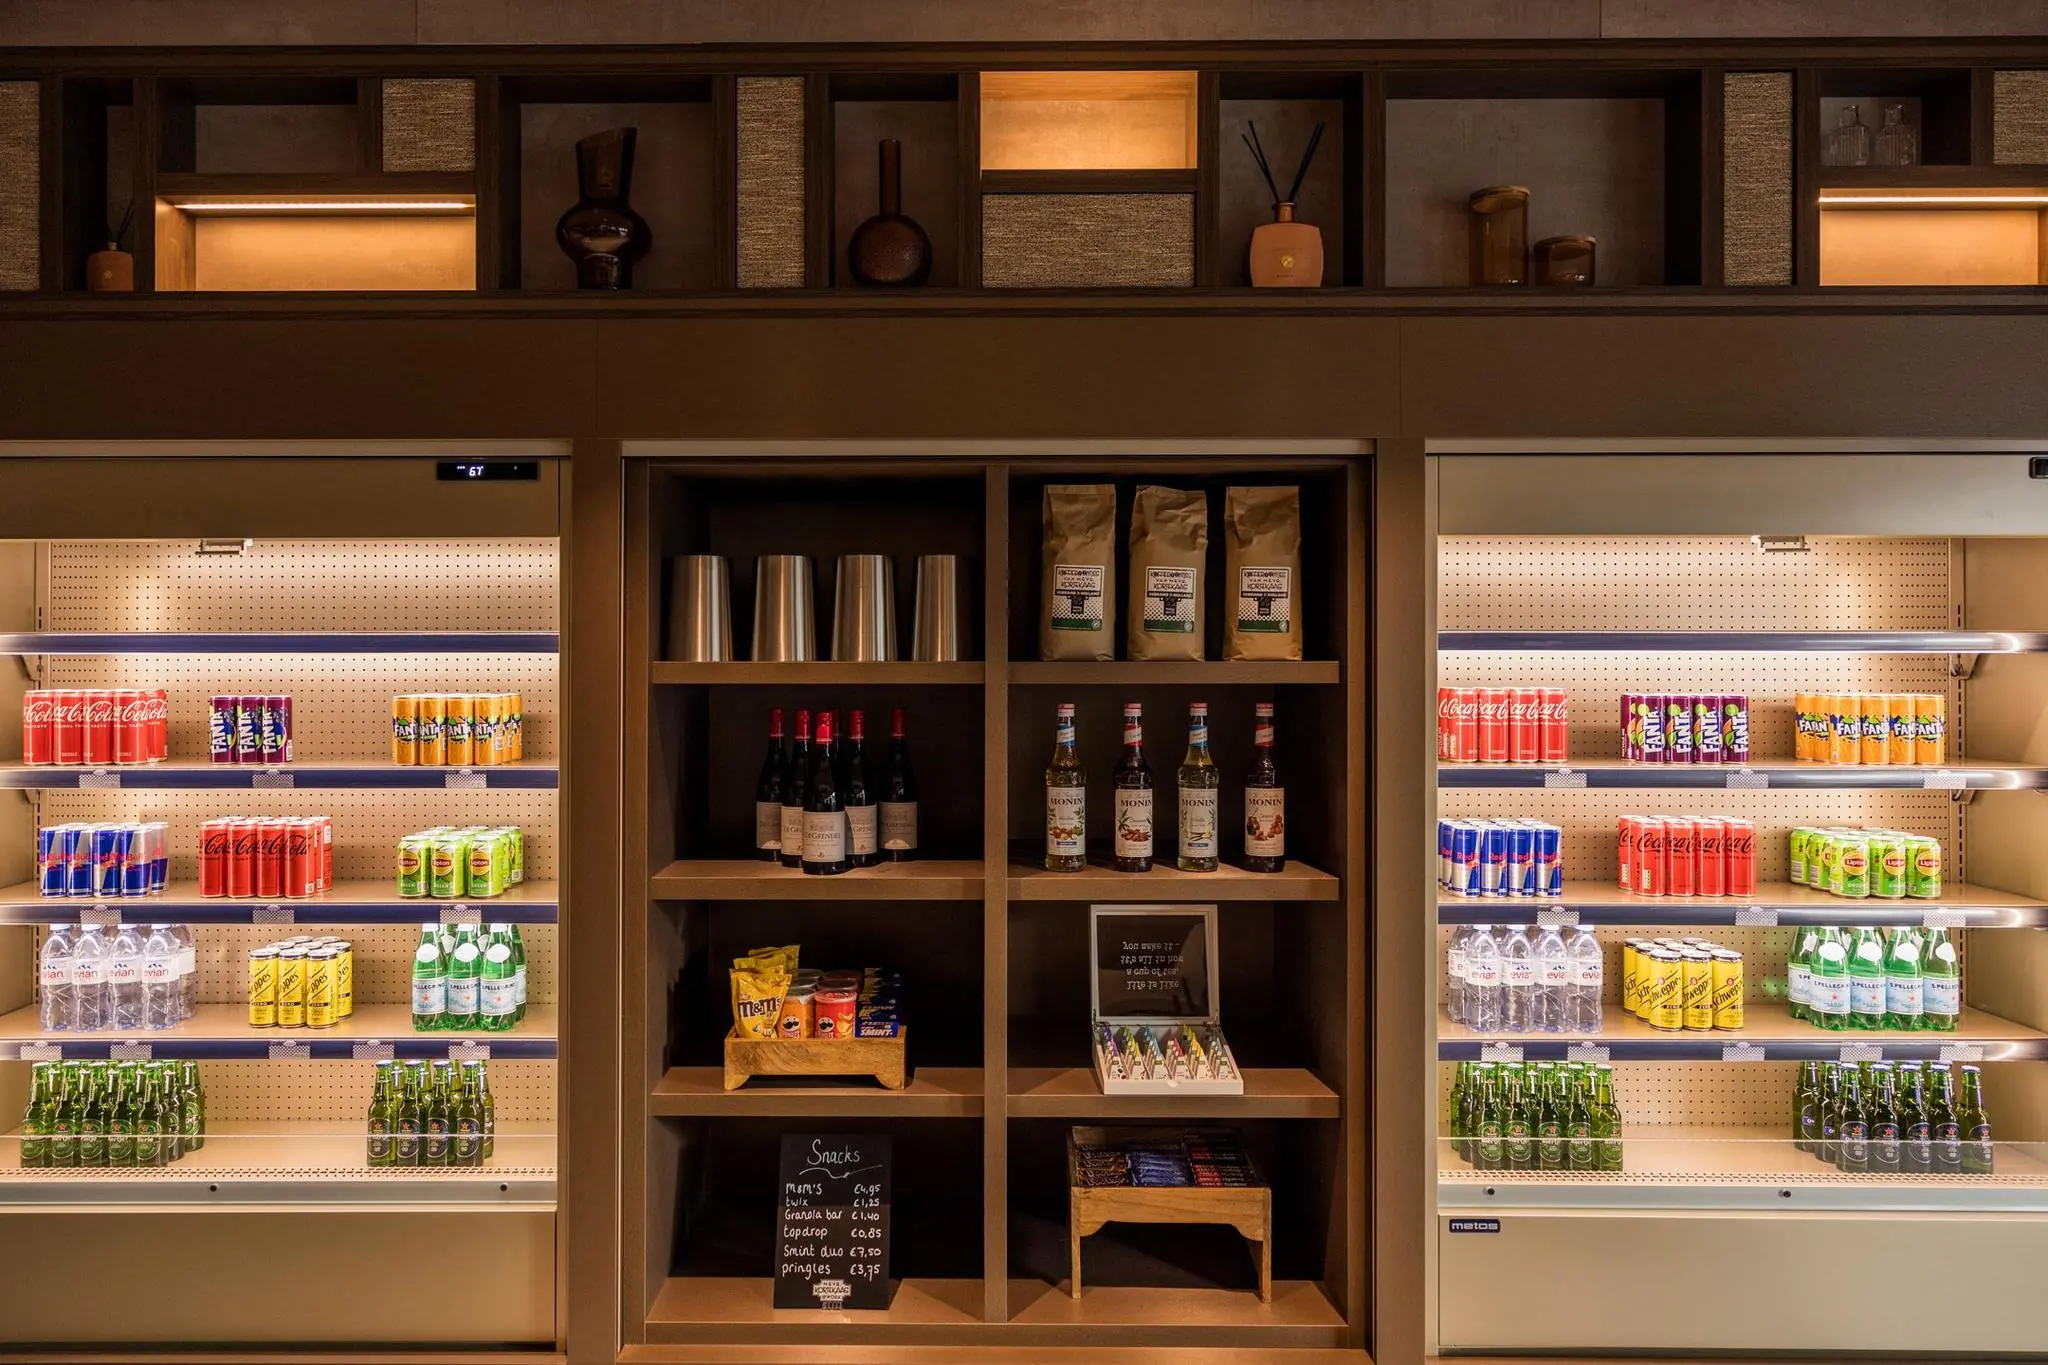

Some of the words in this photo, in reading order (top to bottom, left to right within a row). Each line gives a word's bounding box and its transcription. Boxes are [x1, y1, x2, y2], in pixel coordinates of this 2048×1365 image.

[1050, 797, 1083, 806] MONIN
[1120, 799, 1152, 808] MONIN
[1182, 798, 1215, 807] MONIN
[1249, 798, 1282, 807] MONIN
[807, 1138, 861, 1165] Snacks
[785, 1196, 808, 1207] twix
[853, 1198, 880, 1208] €1,25
[785, 1209, 822, 1220] Granola
[826, 1209, 842, 1220] bar
[783, 1224, 828, 1240] topdrop
[783, 1244, 815, 1257] Smint
[820, 1245, 844, 1258] duo
[850, 1247, 881, 1258] €7,50
[782, 1262, 831, 1280] pringles
[850, 1264, 881, 1282] €3,75
